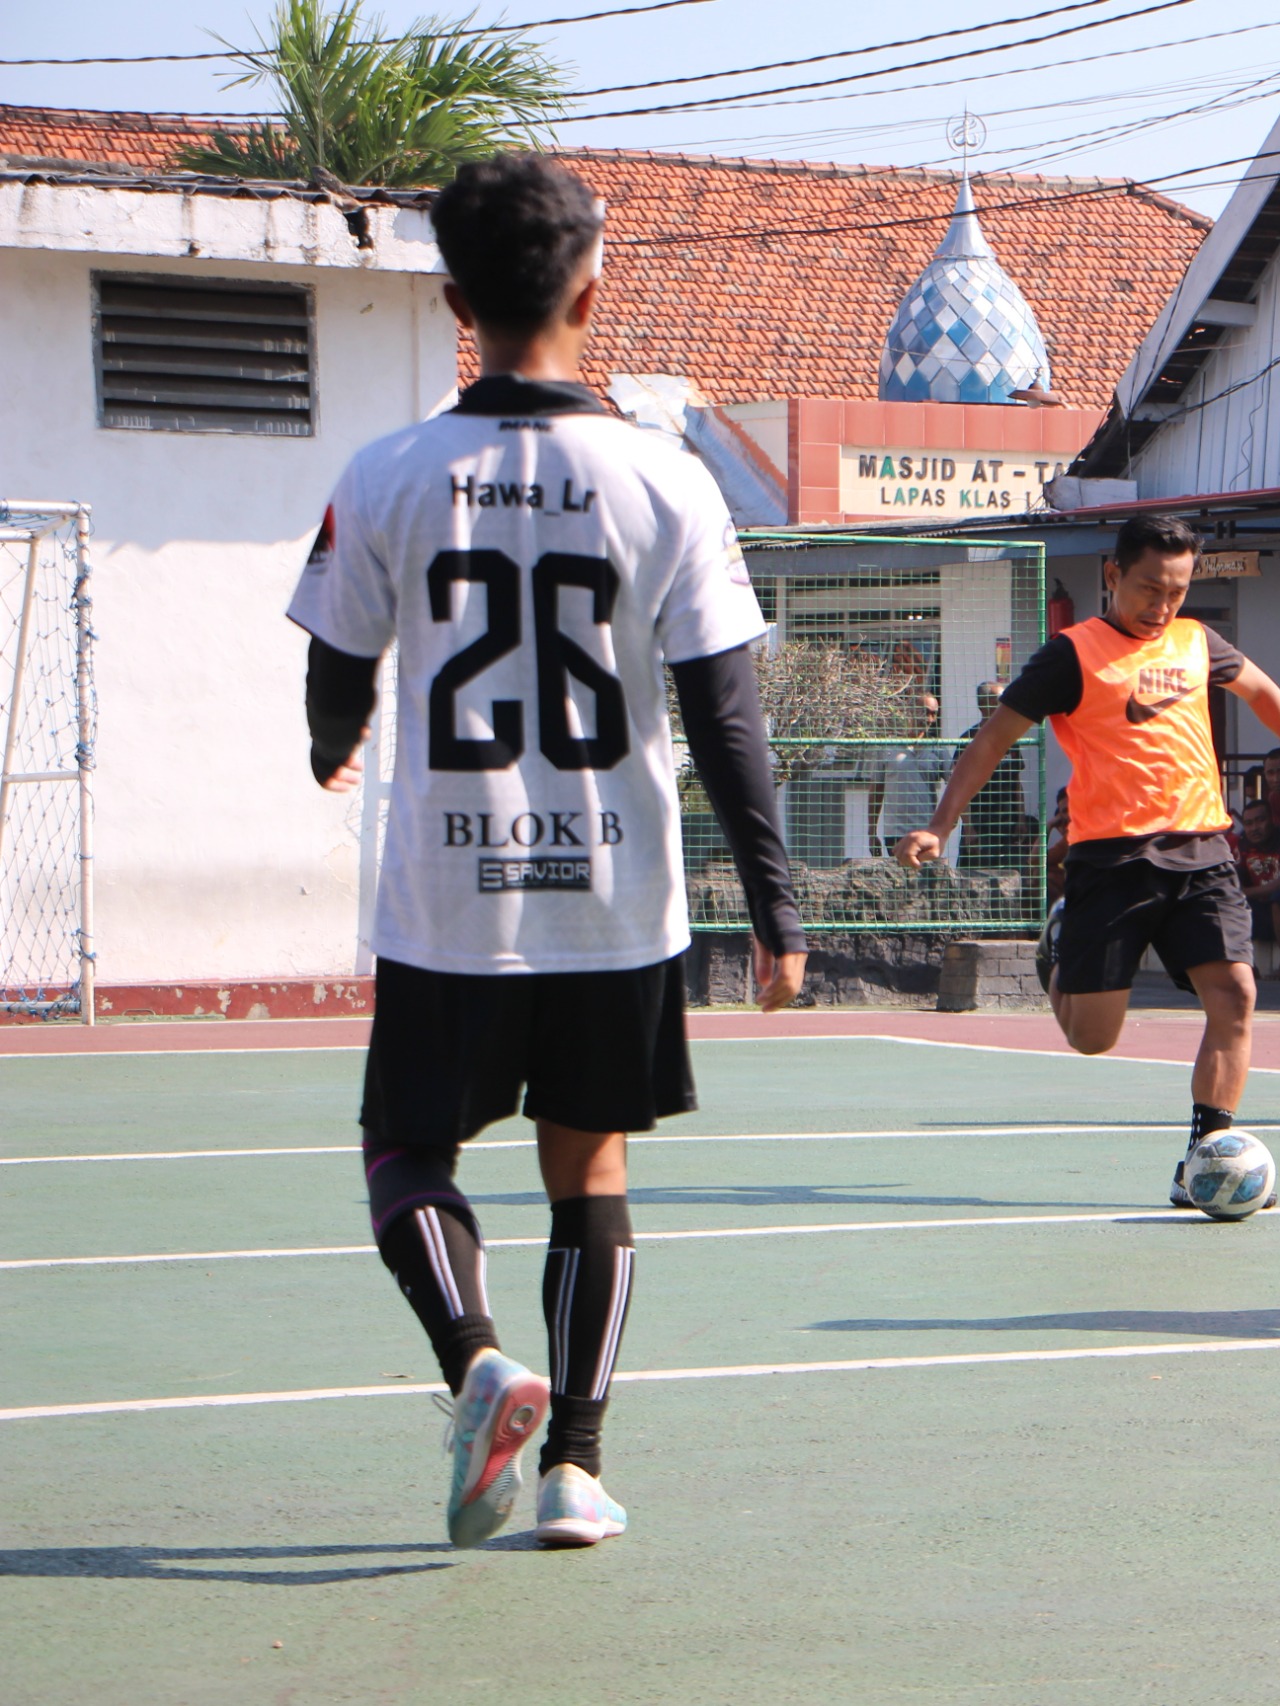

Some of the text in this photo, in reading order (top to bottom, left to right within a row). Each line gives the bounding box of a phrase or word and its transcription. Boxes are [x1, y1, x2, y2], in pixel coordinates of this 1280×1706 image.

[859, 454, 956, 481] MASJID
[972, 459, 1003, 483] AT
[881, 486, 945, 507] LAPAS
[959, 489, 1011, 509] KLAS
[428, 549, 631, 771] 26
[1138, 667, 1188, 694] NIKE
[444, 812, 625, 848] BLOK B
[505, 861, 591, 881] SAVIOR
